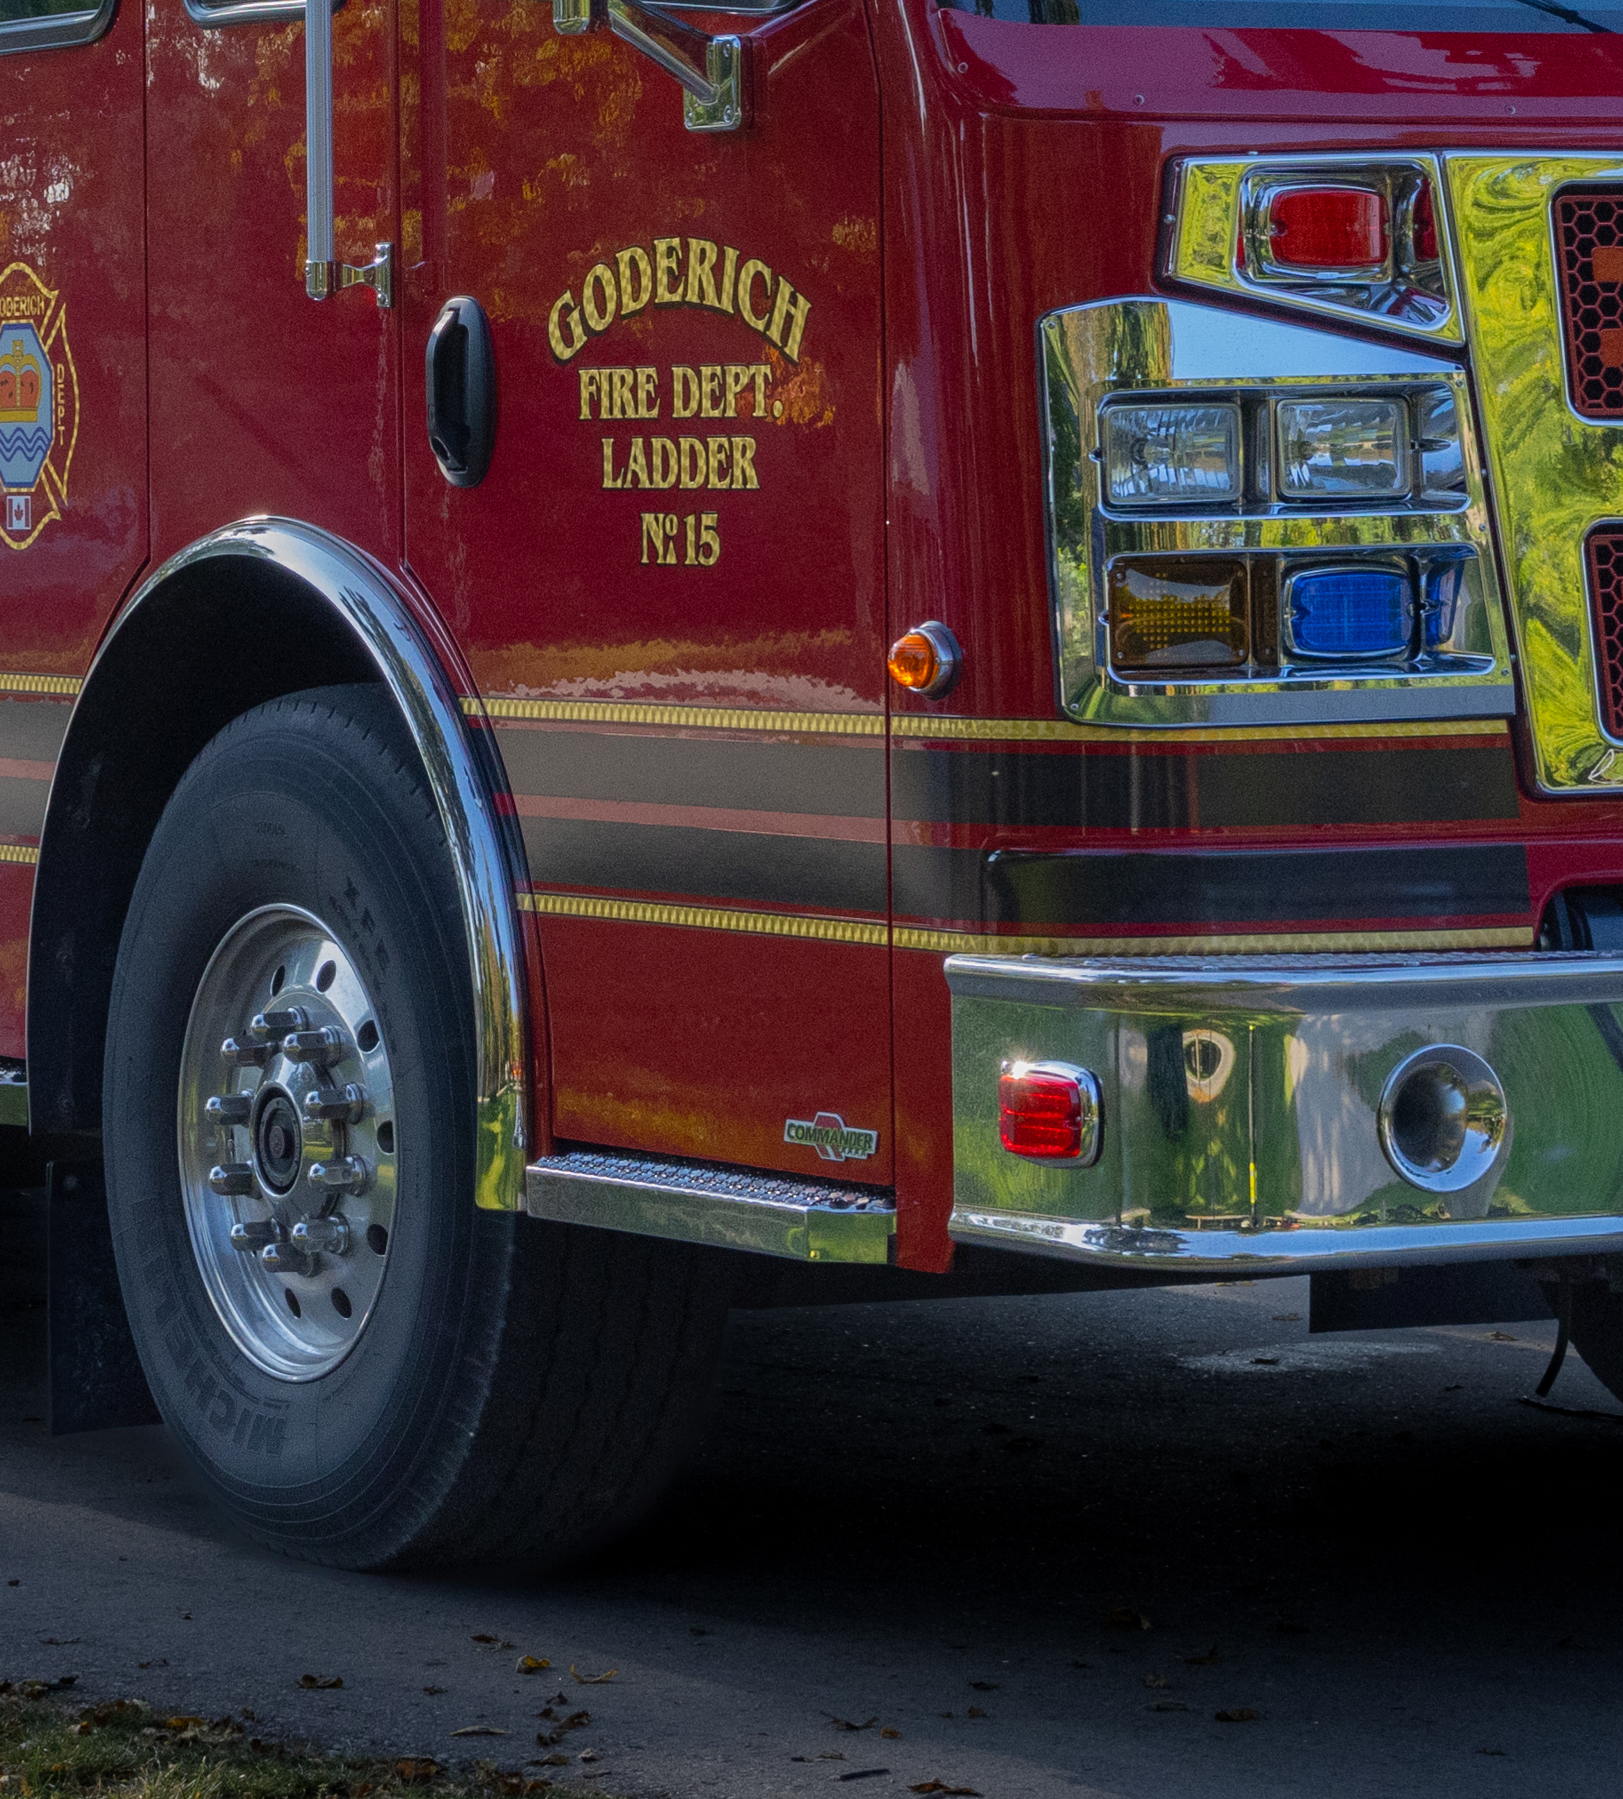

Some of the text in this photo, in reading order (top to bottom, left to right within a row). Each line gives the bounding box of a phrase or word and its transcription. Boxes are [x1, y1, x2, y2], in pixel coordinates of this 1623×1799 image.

[547, 235, 812, 365] GODERICH
[56, 363, 65, 446] DEPT
[578, 364, 784, 420] FIRE DEPT.
[601, 435, 761, 490] LADDER
[786, 1122, 873, 1149] COMMANDER
